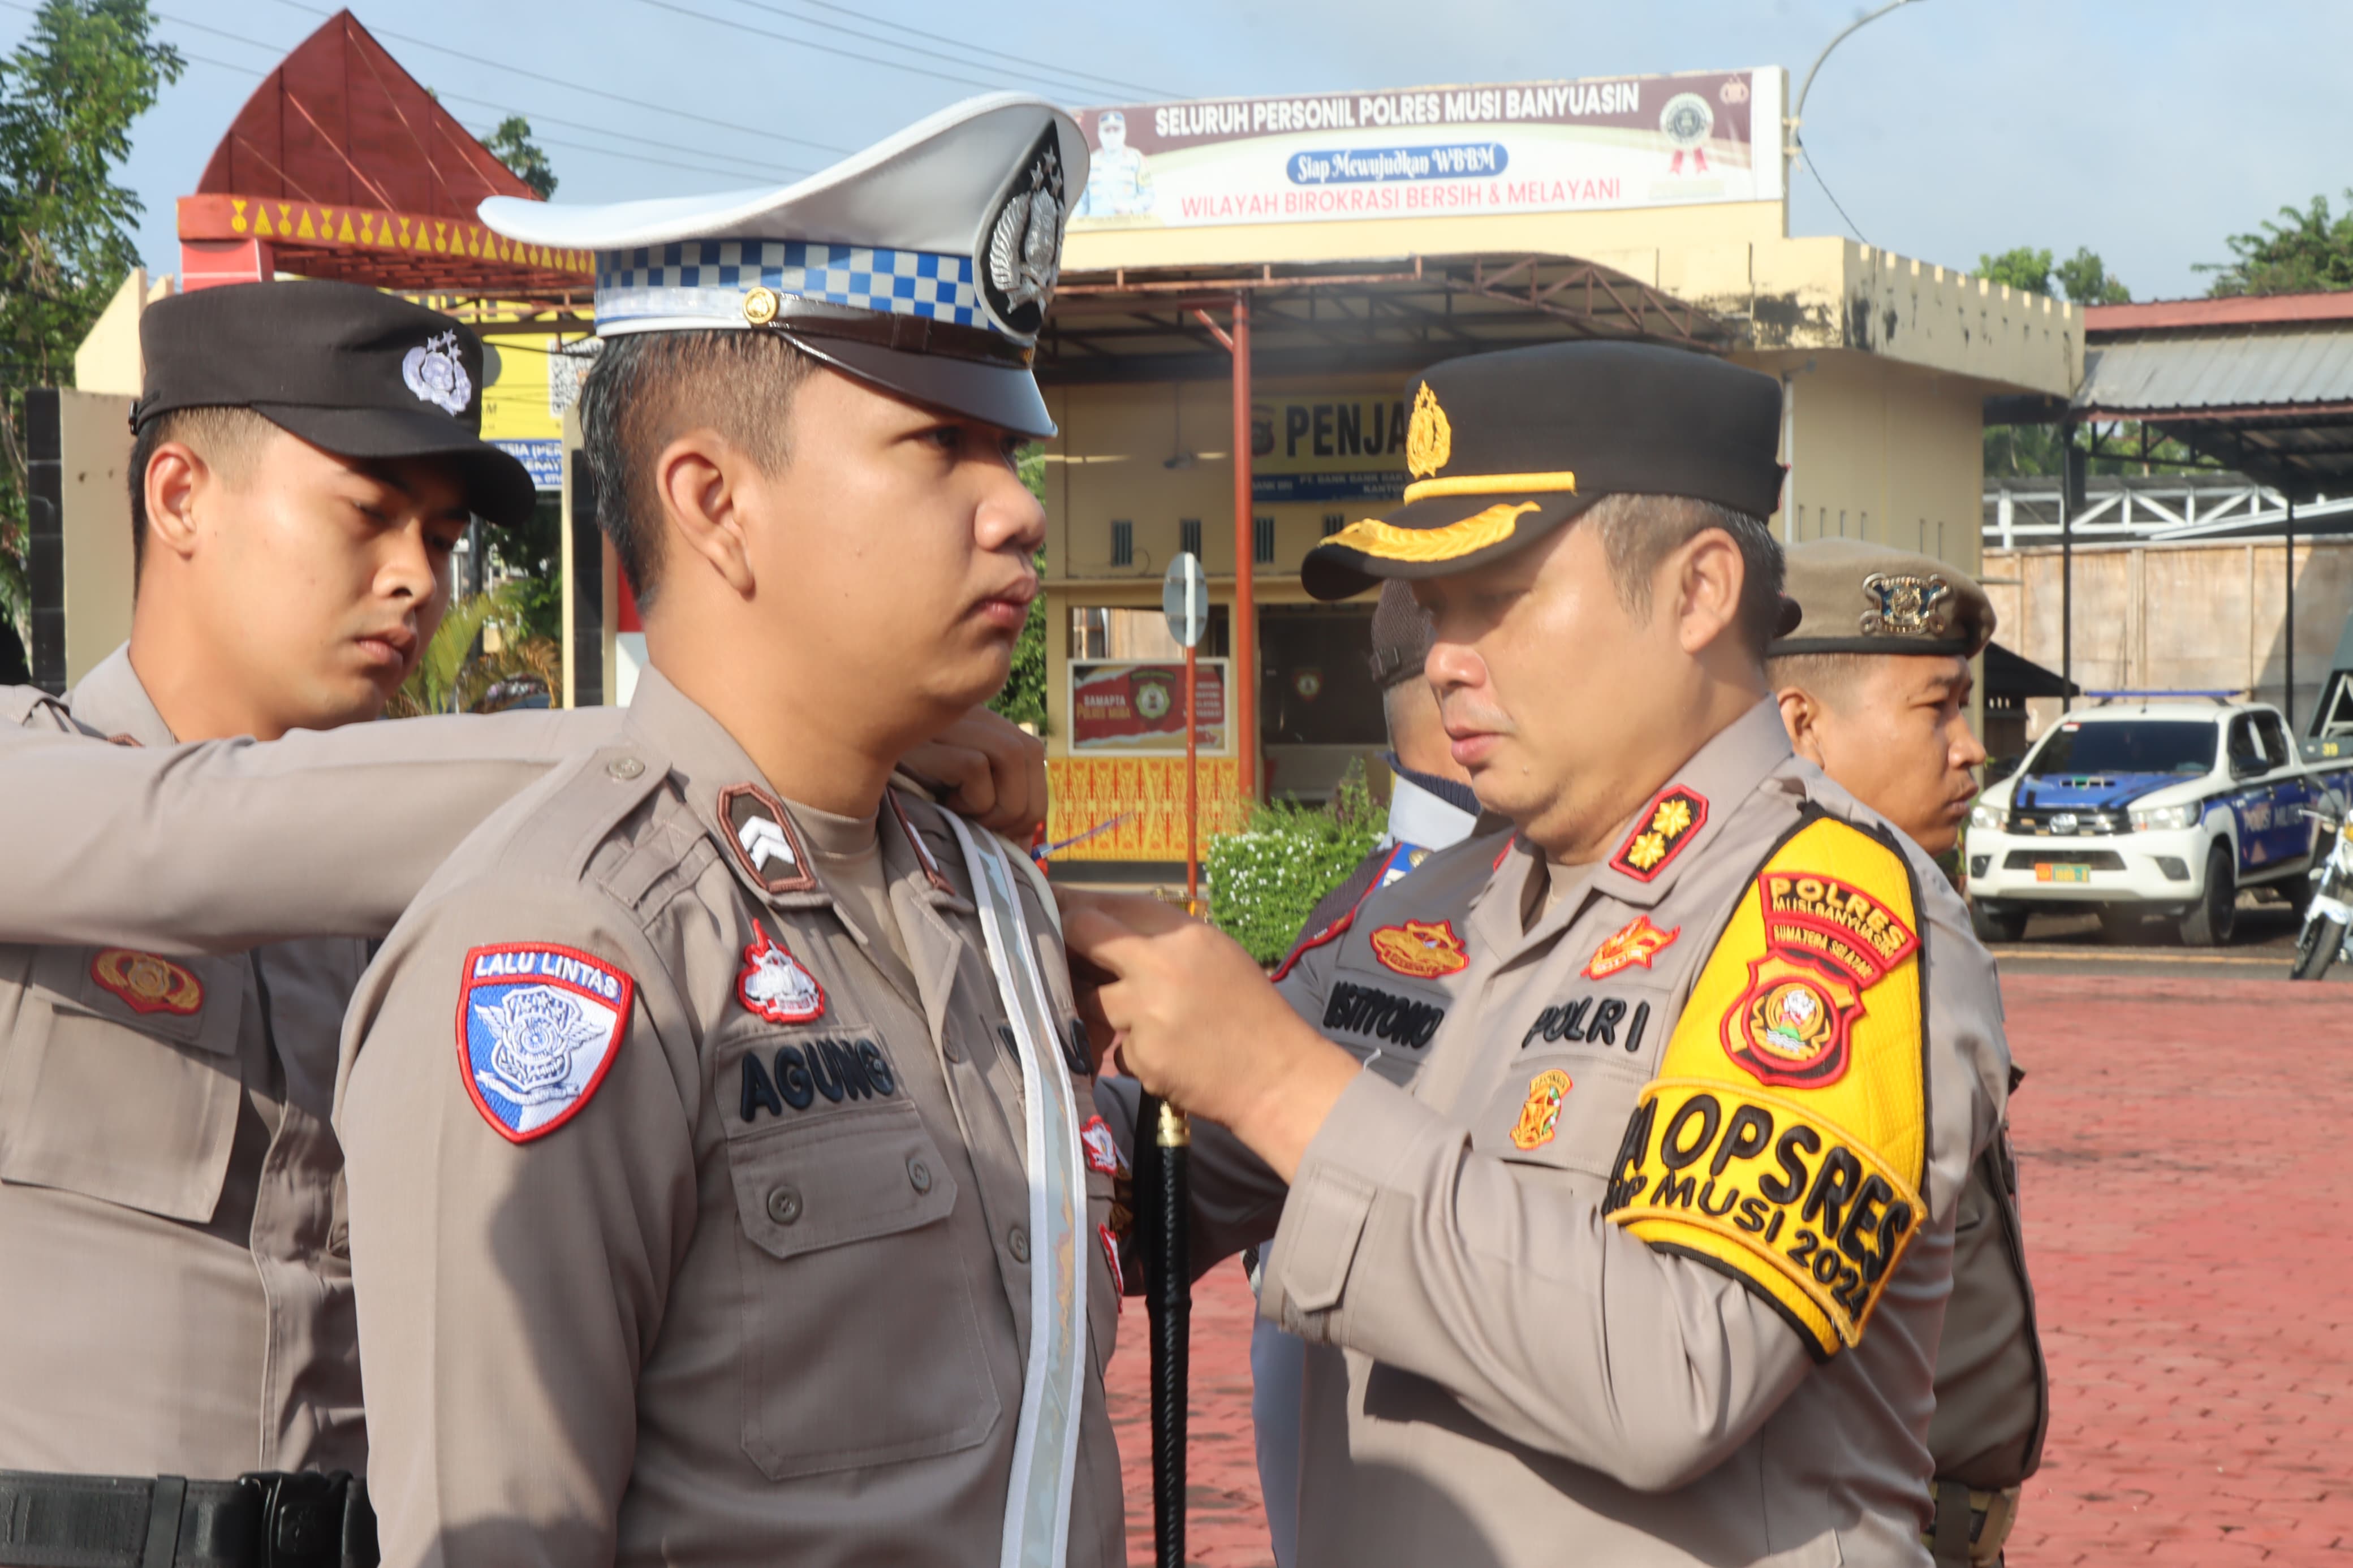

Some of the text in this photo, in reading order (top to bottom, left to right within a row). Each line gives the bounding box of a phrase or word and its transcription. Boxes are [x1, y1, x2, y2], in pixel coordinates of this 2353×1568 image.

[1156, 82, 1639, 137] SELURUH PERSONIL POLRES MUSI BANYUASIN
[1298, 154, 1329, 183] Siap
[1432, 142, 1496, 173] WBBM
[1182, 192, 1278, 218] WILAYAH
[1285, 188, 1399, 214] BIROKRASI
[1407, 184, 1481, 209] BERSIH
[1488, 182, 1500, 204] &
[1509, 178, 1620, 204] MELAYANI
[1769, 876, 1907, 950] POLRES
[475, 951, 619, 999] LALU LINTAS
[1522, 995, 1650, 1052] POLRI
[740, 1038, 894, 1122] AGUNG
[1650, 1172, 1785, 1242] MUSI
